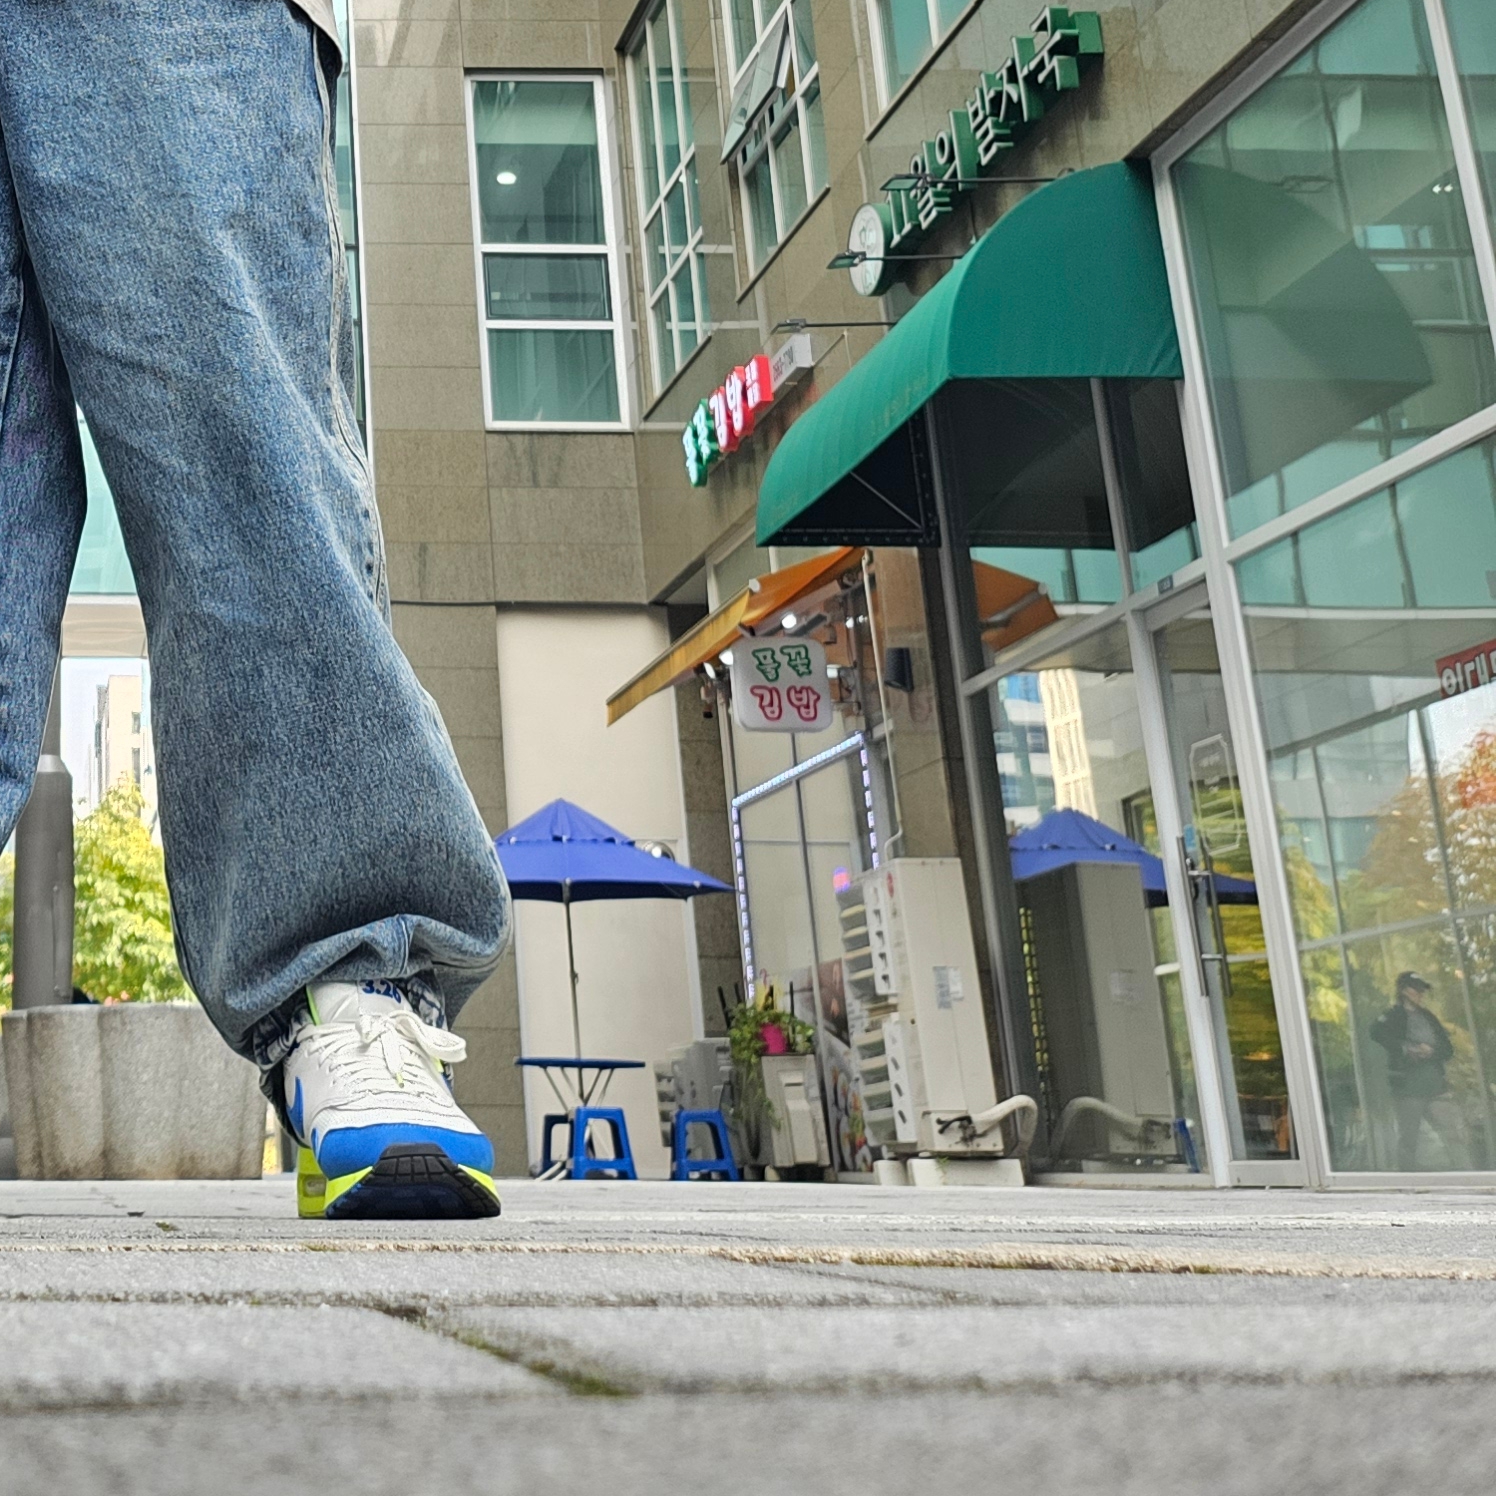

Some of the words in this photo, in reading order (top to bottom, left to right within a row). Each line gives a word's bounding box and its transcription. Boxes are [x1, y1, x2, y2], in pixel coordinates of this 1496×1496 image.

[966, 4, 1062, 166] 발자국
[751, 644, 813, 683] 풀꽃
[750, 685, 821, 722] 김밥
